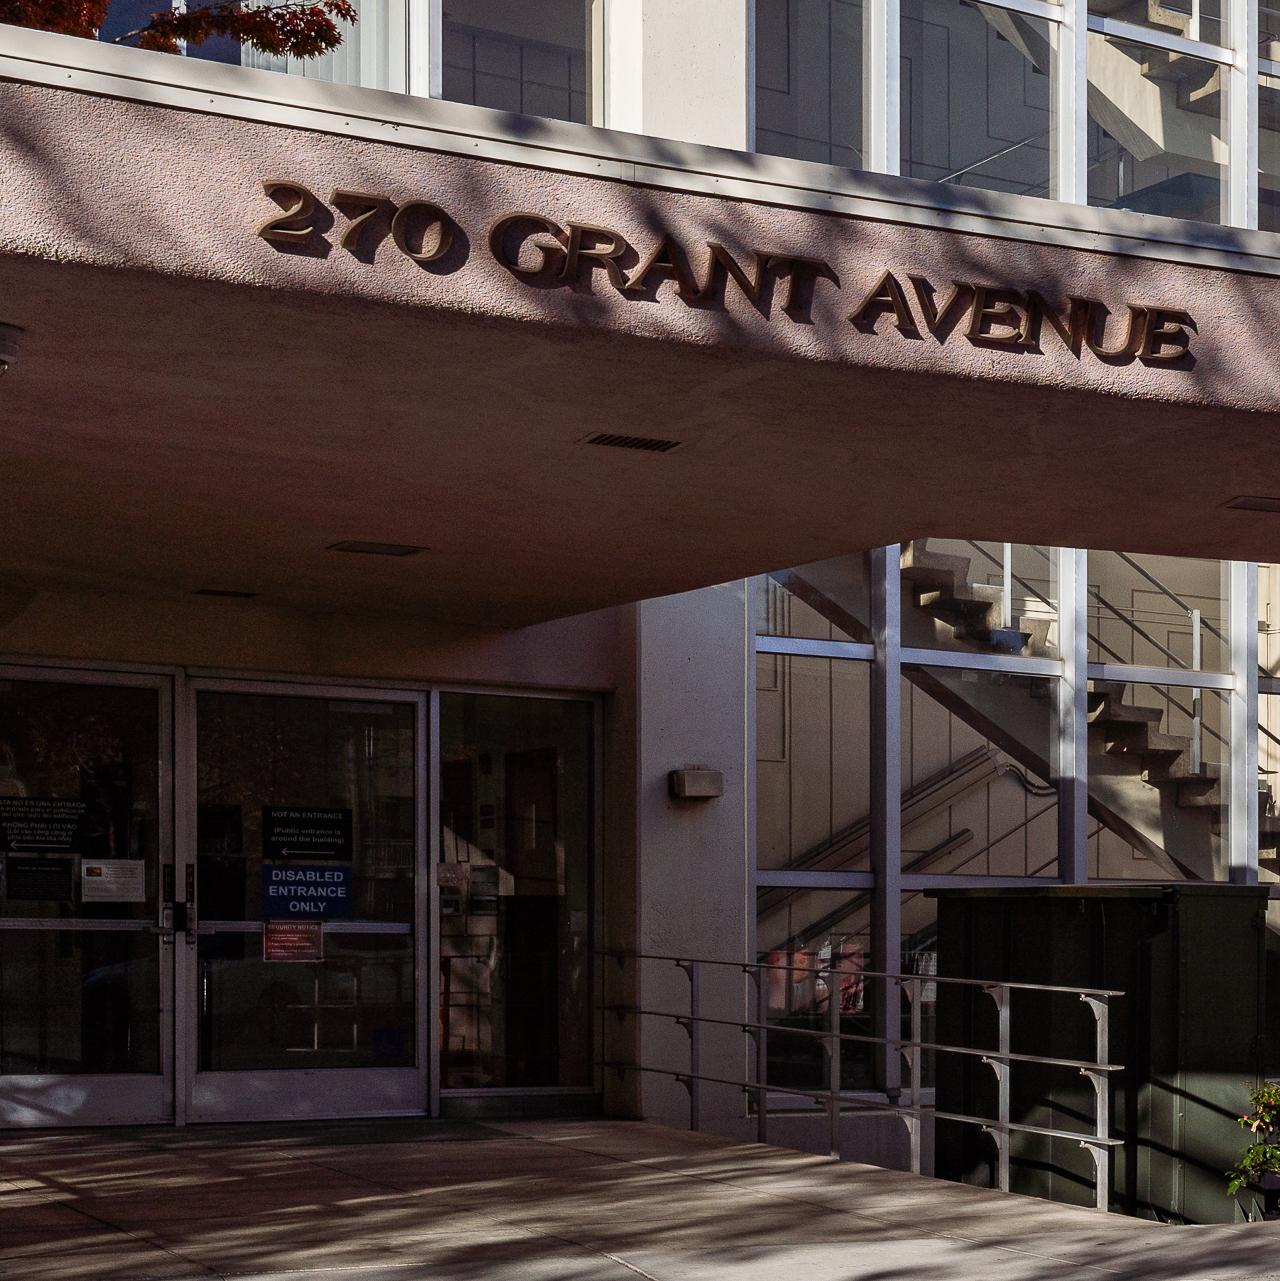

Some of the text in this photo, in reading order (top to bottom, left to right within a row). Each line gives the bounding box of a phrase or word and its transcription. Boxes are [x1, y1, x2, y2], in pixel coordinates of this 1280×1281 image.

[255, 178, 1198, 363] 270 GRANT AVENUE
[272, 870, 344, 882] DISABLED
[269, 886, 346, 897] ENTRANCE
[289, 901, 327, 912] ONLY
